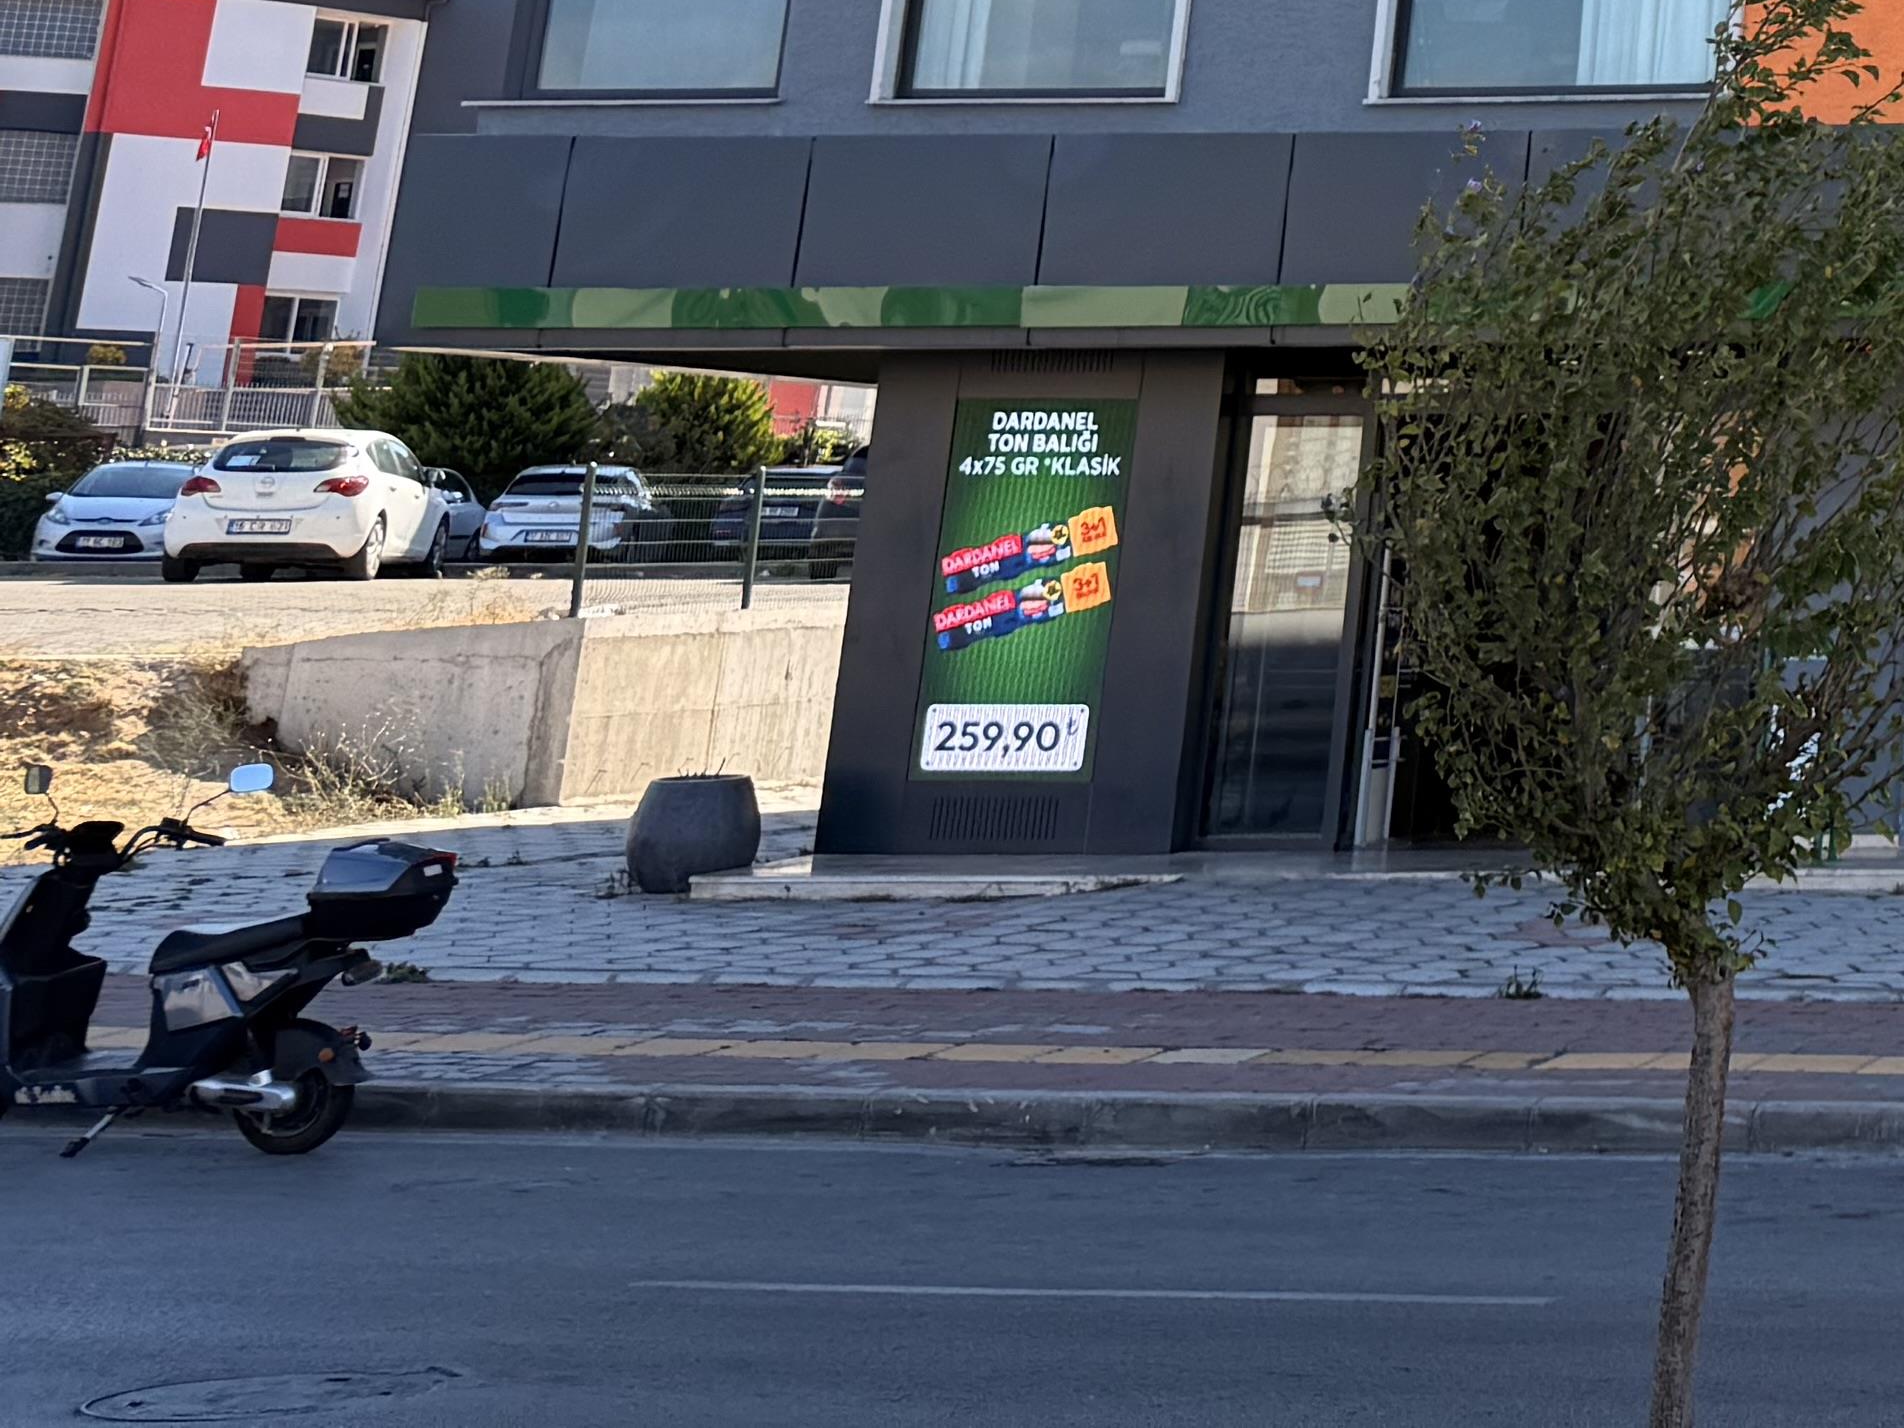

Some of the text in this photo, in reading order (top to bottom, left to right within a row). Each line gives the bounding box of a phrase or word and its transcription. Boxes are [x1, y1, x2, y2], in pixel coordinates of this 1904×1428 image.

[992, 411, 1099, 432] DARDANEL
[988, 429, 1099, 453] TON BALIĞI
[958, 456, 1007, 476] 4x75
[1010, 456, 1039, 475] GR
[942, 539, 1018, 574] DARDANEL
[972, 561, 1000, 578] TON
[934, 594, 1011, 630] DARDANEL
[964, 617, 993, 634] TON
